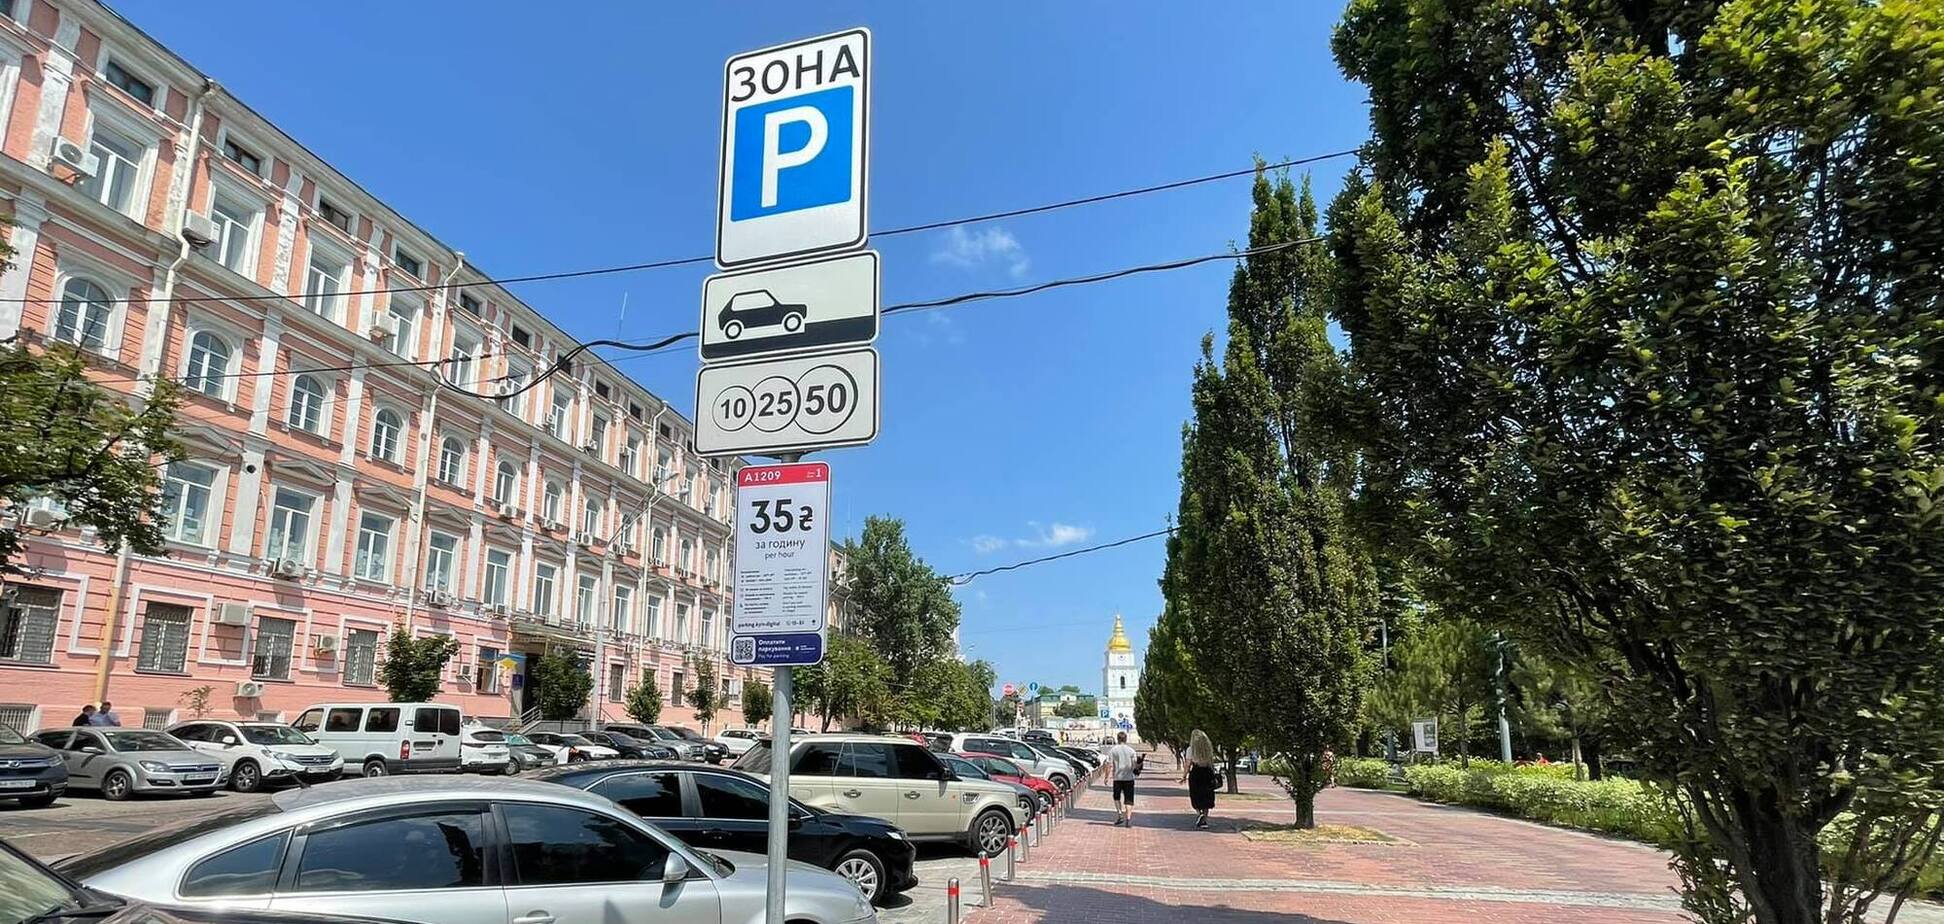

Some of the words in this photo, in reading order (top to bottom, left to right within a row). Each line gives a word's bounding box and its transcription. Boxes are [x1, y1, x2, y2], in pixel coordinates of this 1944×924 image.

[731, 44, 861, 102] ЗОНА
[761, 105, 828, 209] P
[720, 397, 746, 421] 10
[758, 390, 793, 417] 25
[804, 382, 847, 416] 50
[744, 470, 781, 482] A1209
[755, 541, 766, 550] за
[768, 539, 806, 550] годину
[778, 551, 795, 559] hour
